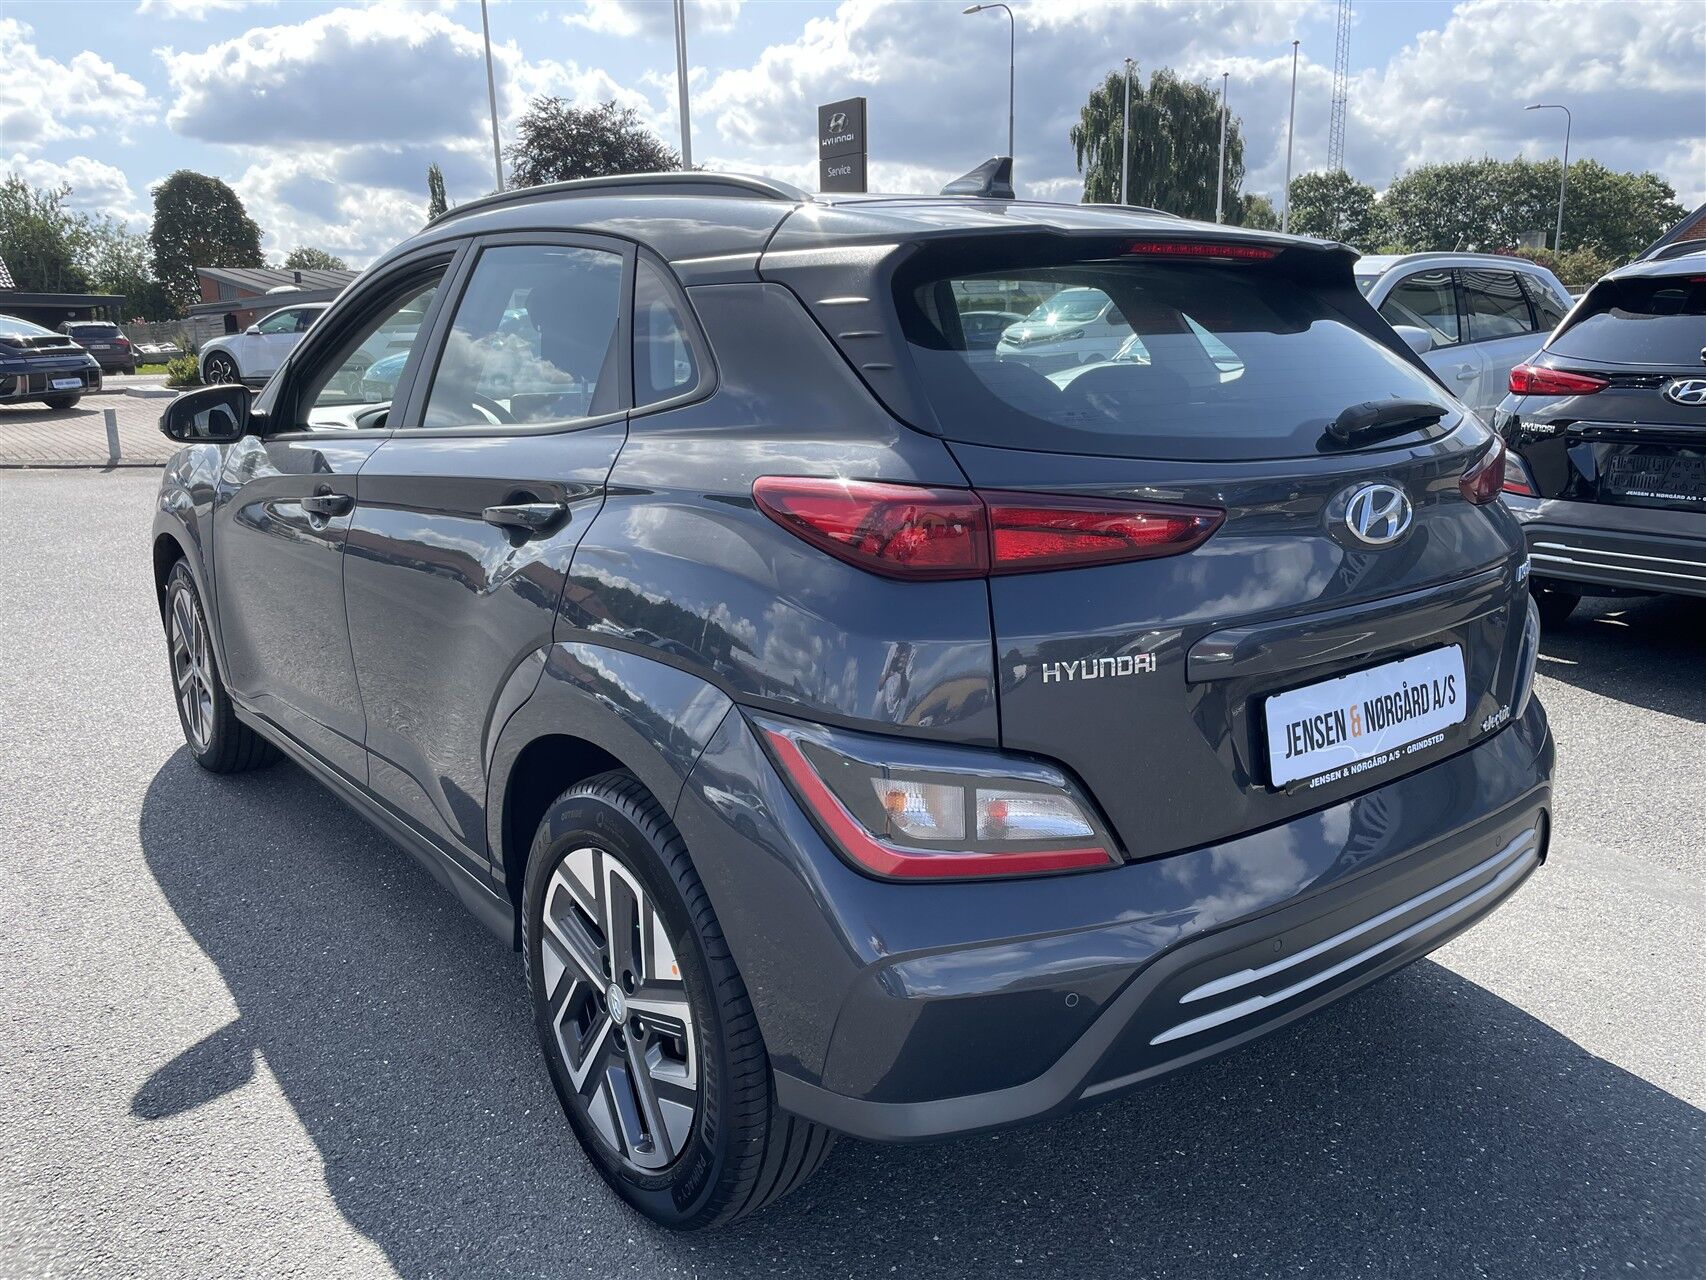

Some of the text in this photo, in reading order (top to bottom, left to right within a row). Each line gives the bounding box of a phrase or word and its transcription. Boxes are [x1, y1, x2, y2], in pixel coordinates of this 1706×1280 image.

[822, 133, 854, 146] HYUNDAI
[828, 165, 851, 177] Service
[1520, 421, 1556, 434] HYUNDAI
[1042, 652, 1157, 683] HYUNDAI
[1285, 674, 1456, 759] JENSEN & NØRGÅRD A/S
[1309, 733, 1445, 789] JENSEN & NØRGÅRD A/S GRINDSTED
